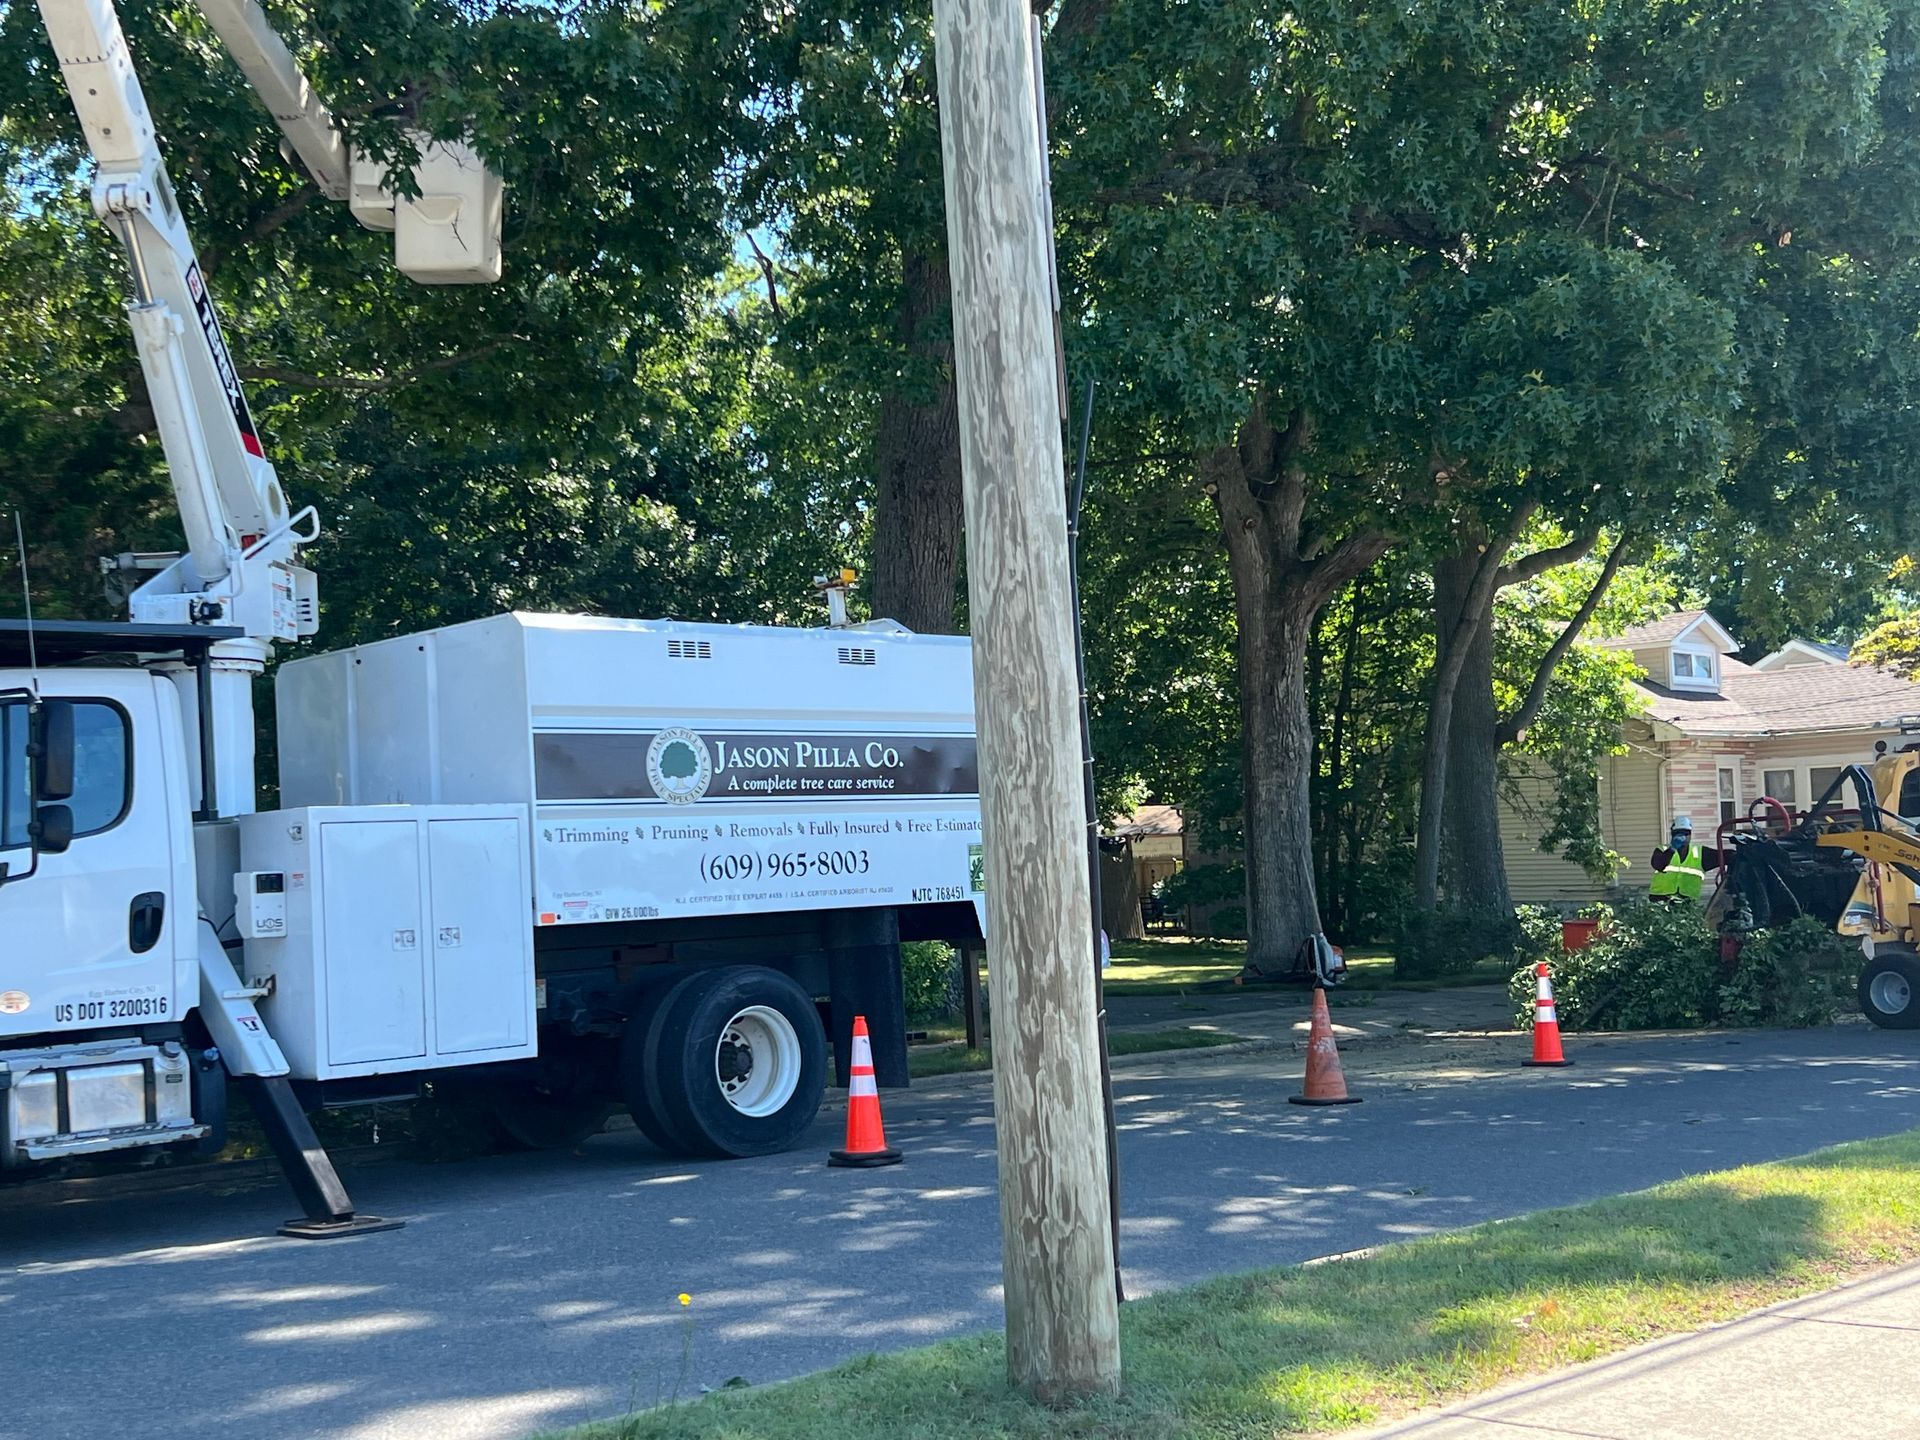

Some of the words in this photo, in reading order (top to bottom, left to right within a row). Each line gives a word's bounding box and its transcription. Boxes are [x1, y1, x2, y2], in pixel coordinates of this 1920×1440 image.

[714, 741, 790, 775] JASON
[794, 741, 861, 768] PILLA
[728, 775, 740, 791] A
[743, 774, 797, 794] complete
[801, 777, 824, 790] tree
[827, 776, 853, 790] care
[856, 775, 895, 790] service
[555, 826, 629, 844] Trimming
[652, 824, 708, 841] Pruning
[730, 821, 793, 838] Removals
[809, 820, 840, 838] Fully
[845, 819, 889, 835] Insured
[908, 818, 933, 832] Free
[700, 851, 762, 884] (609)
[768, 850, 869, 878] 965-8003
[689, 894, 724, 904] CERTIFIED
[725, 893, 741, 902] TREE
[743, 892, 767, 901] EXPERT
[807, 888, 838, 897] CERTIFIED
[839, 887, 868, 896] ARBORIST
[912, 888, 932, 902] NJTC
[936, 886, 964, 900] 768451
[55, 1004, 74, 1023] US
[77, 1001, 105, 1021] DOT
[109, 996, 168, 1018] 3200316
